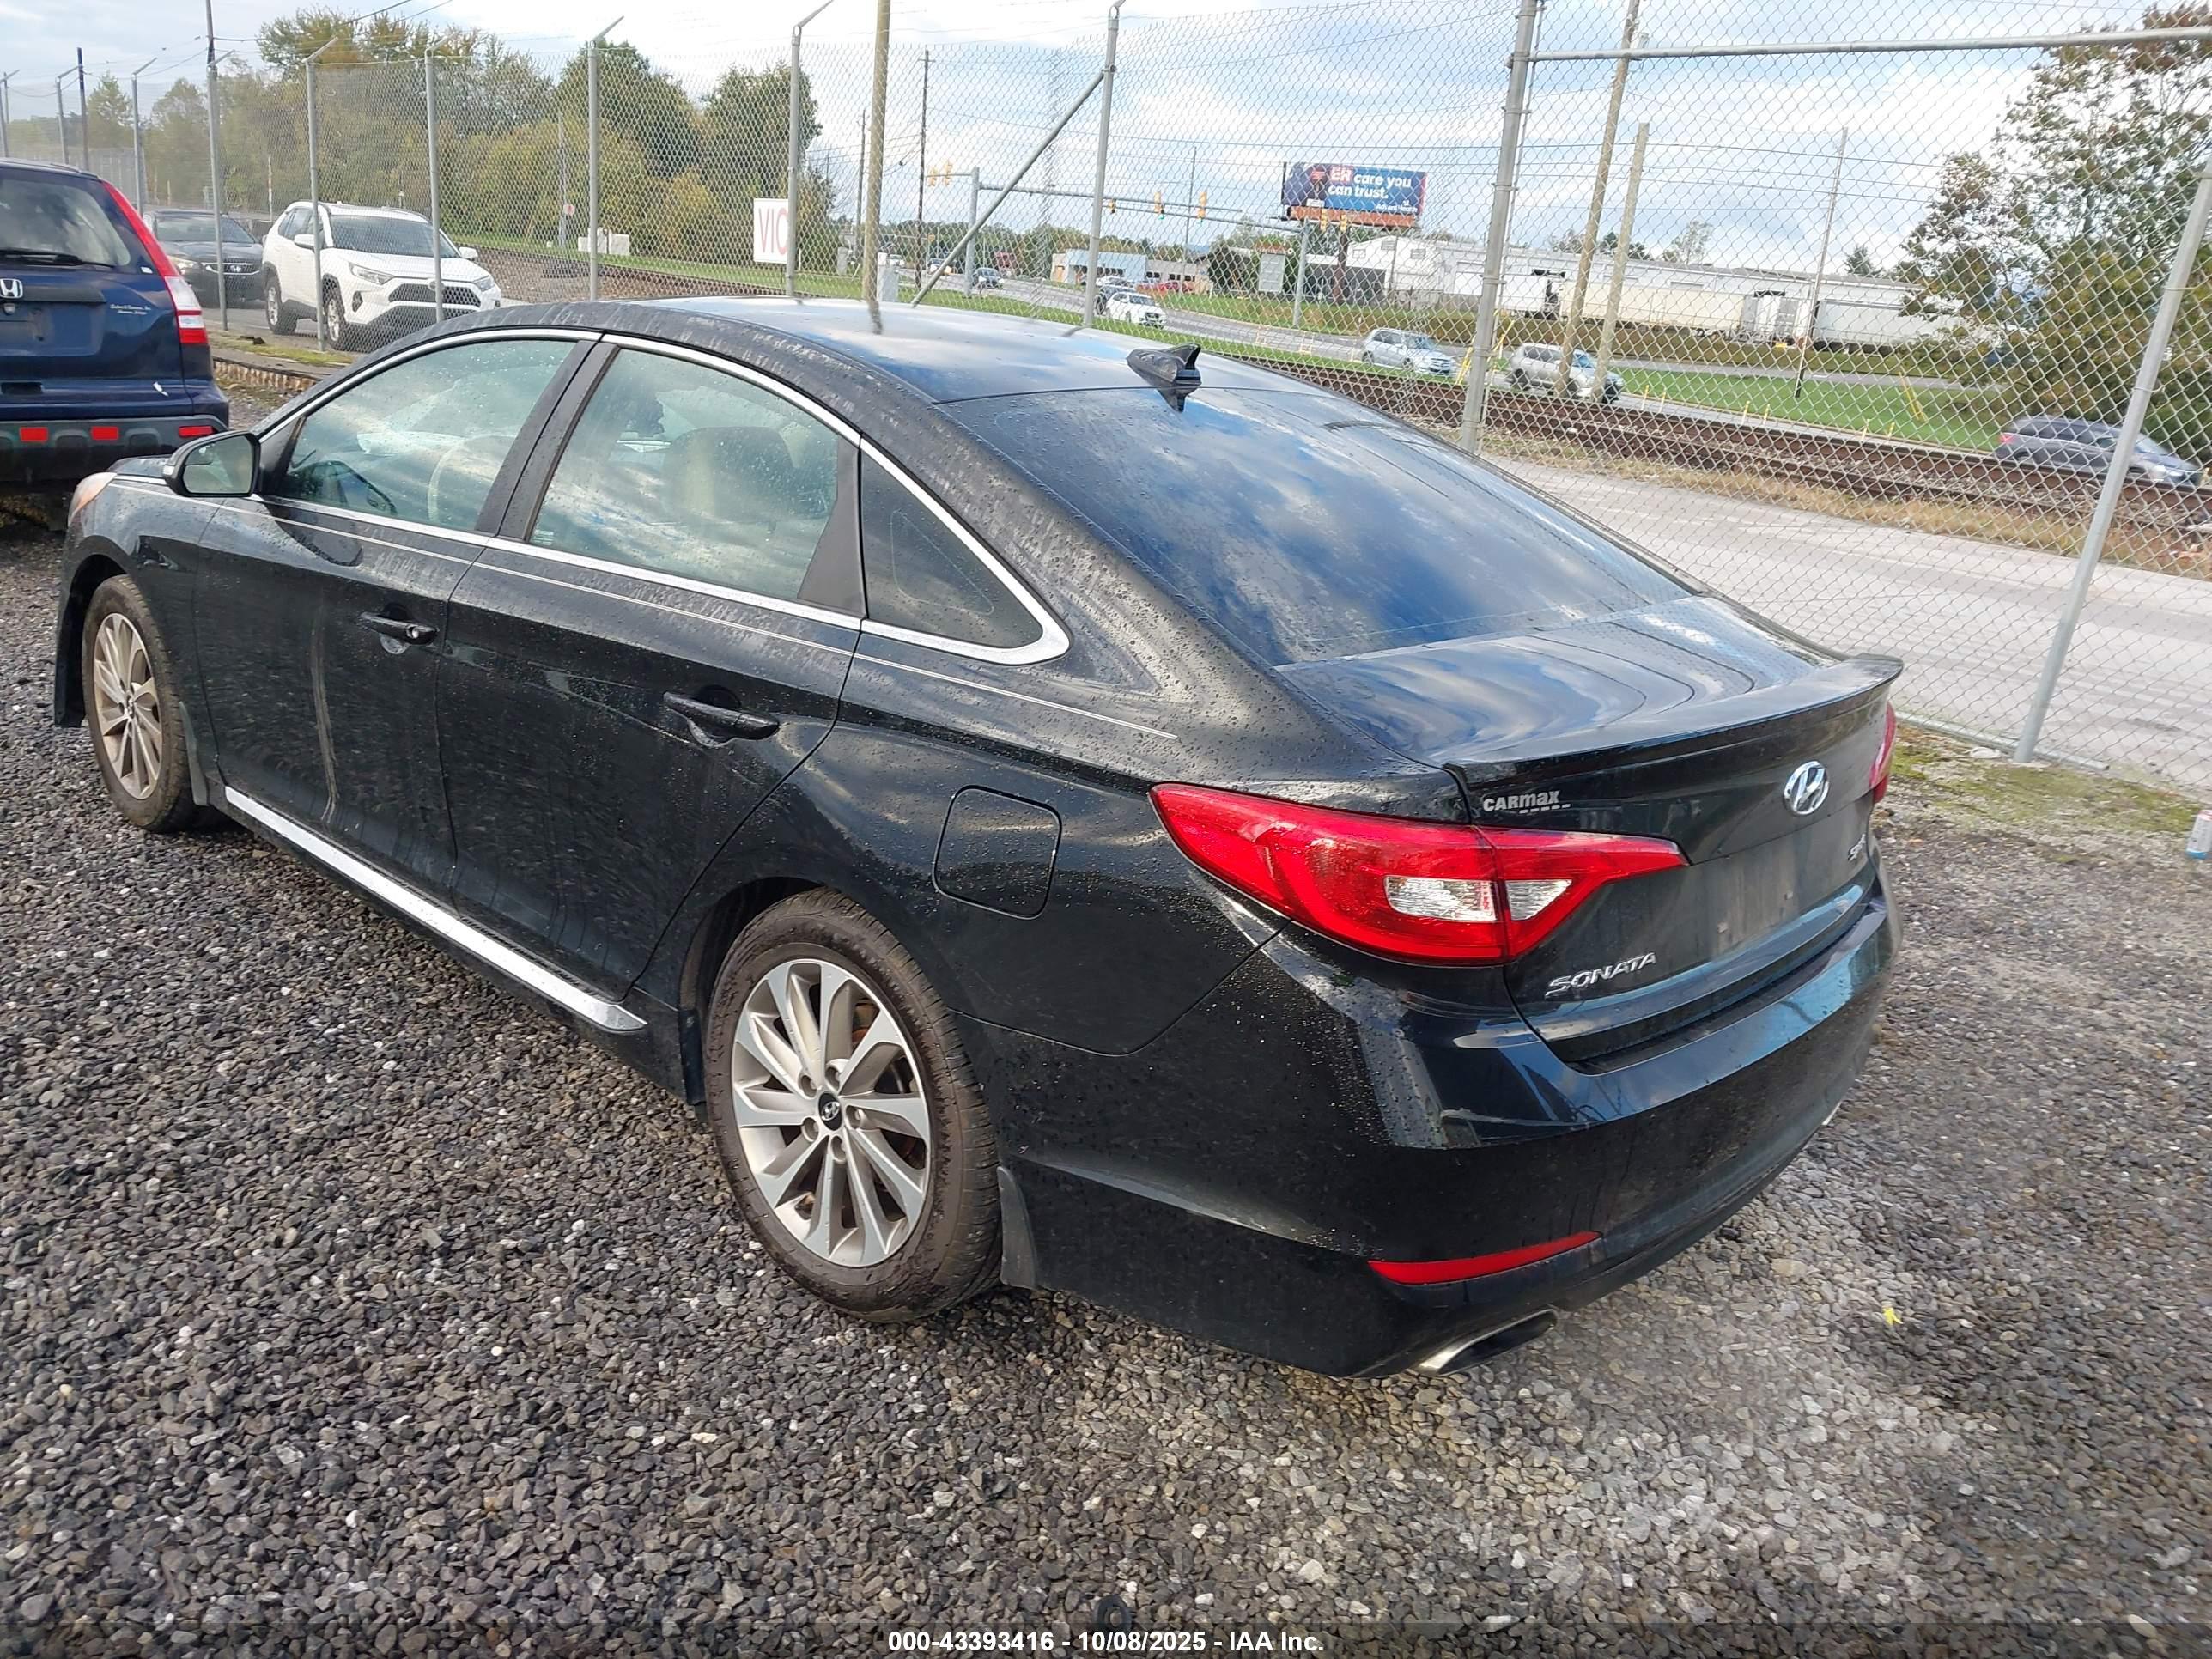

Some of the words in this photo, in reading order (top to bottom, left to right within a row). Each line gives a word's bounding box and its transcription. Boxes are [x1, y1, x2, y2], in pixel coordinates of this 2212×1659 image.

[1353, 173, 1384, 185] care
[1386, 177, 1413, 189] you
[1328, 185, 1353, 197] can
[1354, 186, 1389, 199] trust.
[1545, 952, 1656, 997] SONATA
